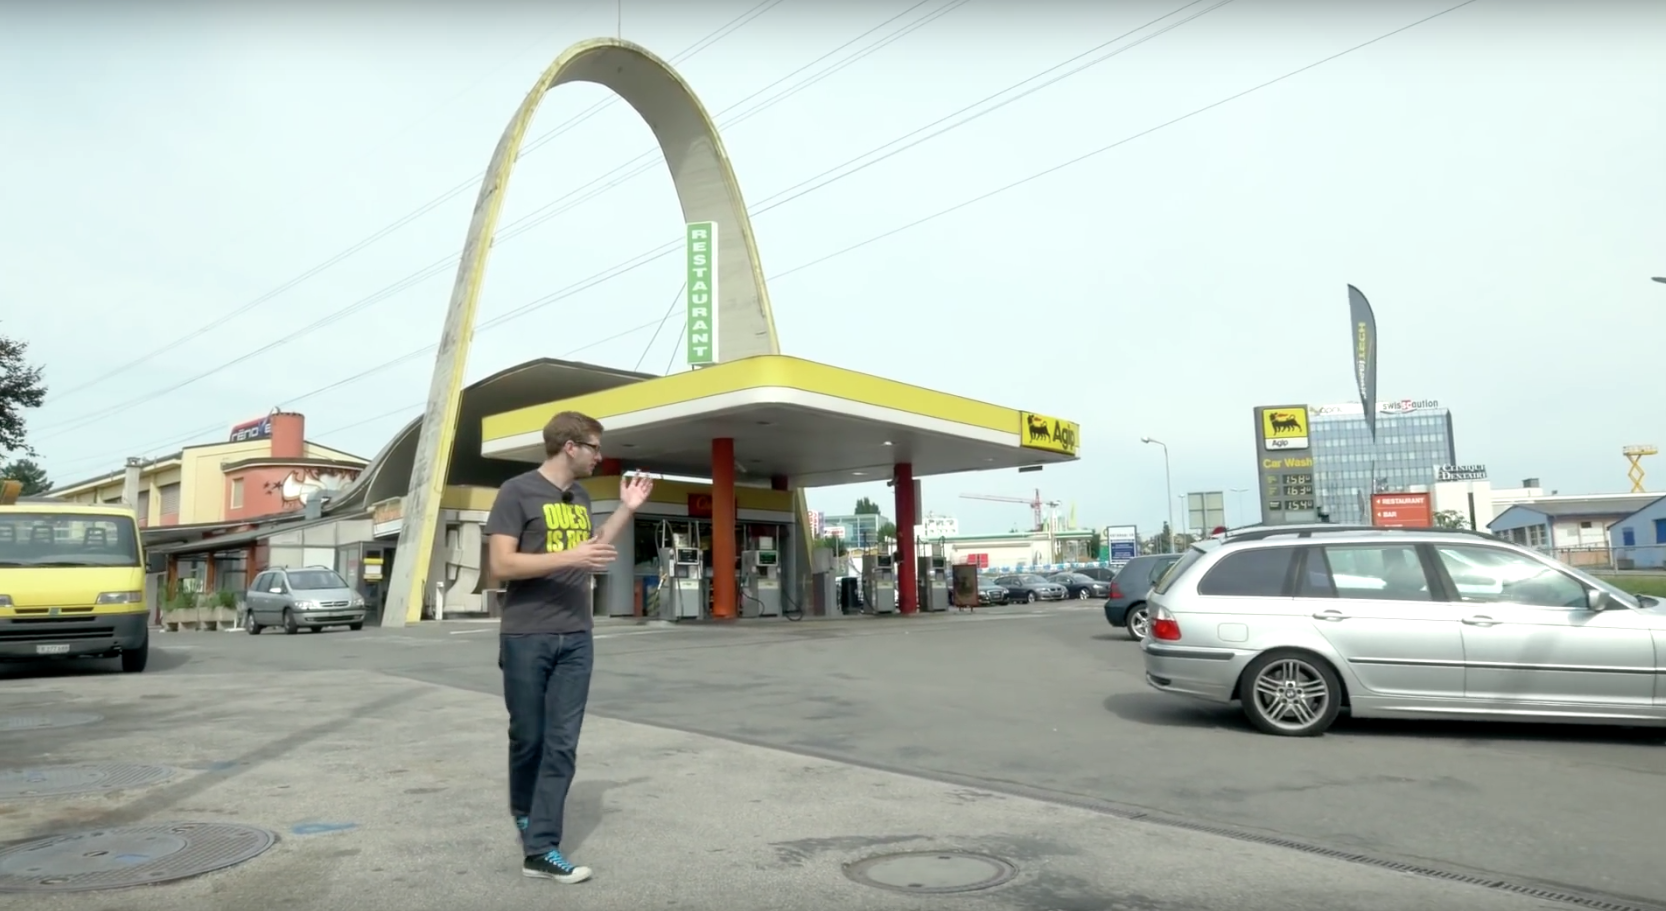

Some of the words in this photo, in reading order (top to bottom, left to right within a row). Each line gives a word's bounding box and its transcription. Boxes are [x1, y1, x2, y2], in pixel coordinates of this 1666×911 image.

[691, 229, 708, 357] RESTAURANT
[1053, 420, 1075, 451] Agip
[1272, 440, 1289, 448] Agip
[1263, 459, 1282, 469] Car
[1284, 457, 1313, 468] Wash
[1382, 497, 1424, 505] RESTAURANT
[547, 530, 564, 553] IS
